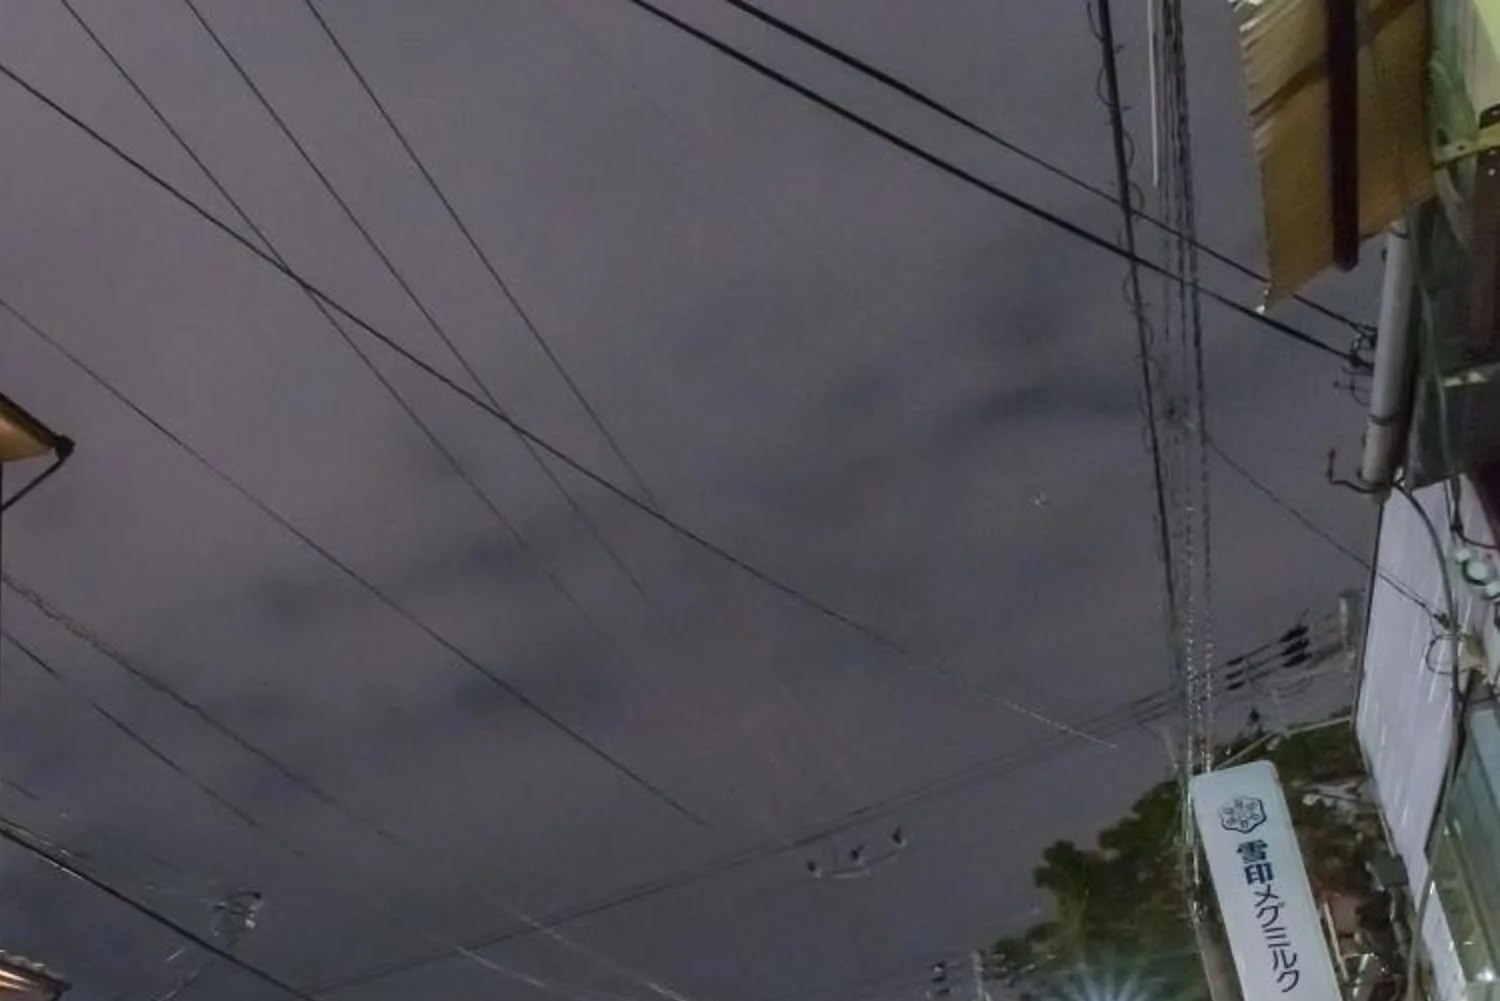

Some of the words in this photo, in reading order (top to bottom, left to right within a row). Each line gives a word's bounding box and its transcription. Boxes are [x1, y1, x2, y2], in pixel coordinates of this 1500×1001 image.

[1236, 839, 1300, 992] 雪印メグミルク
